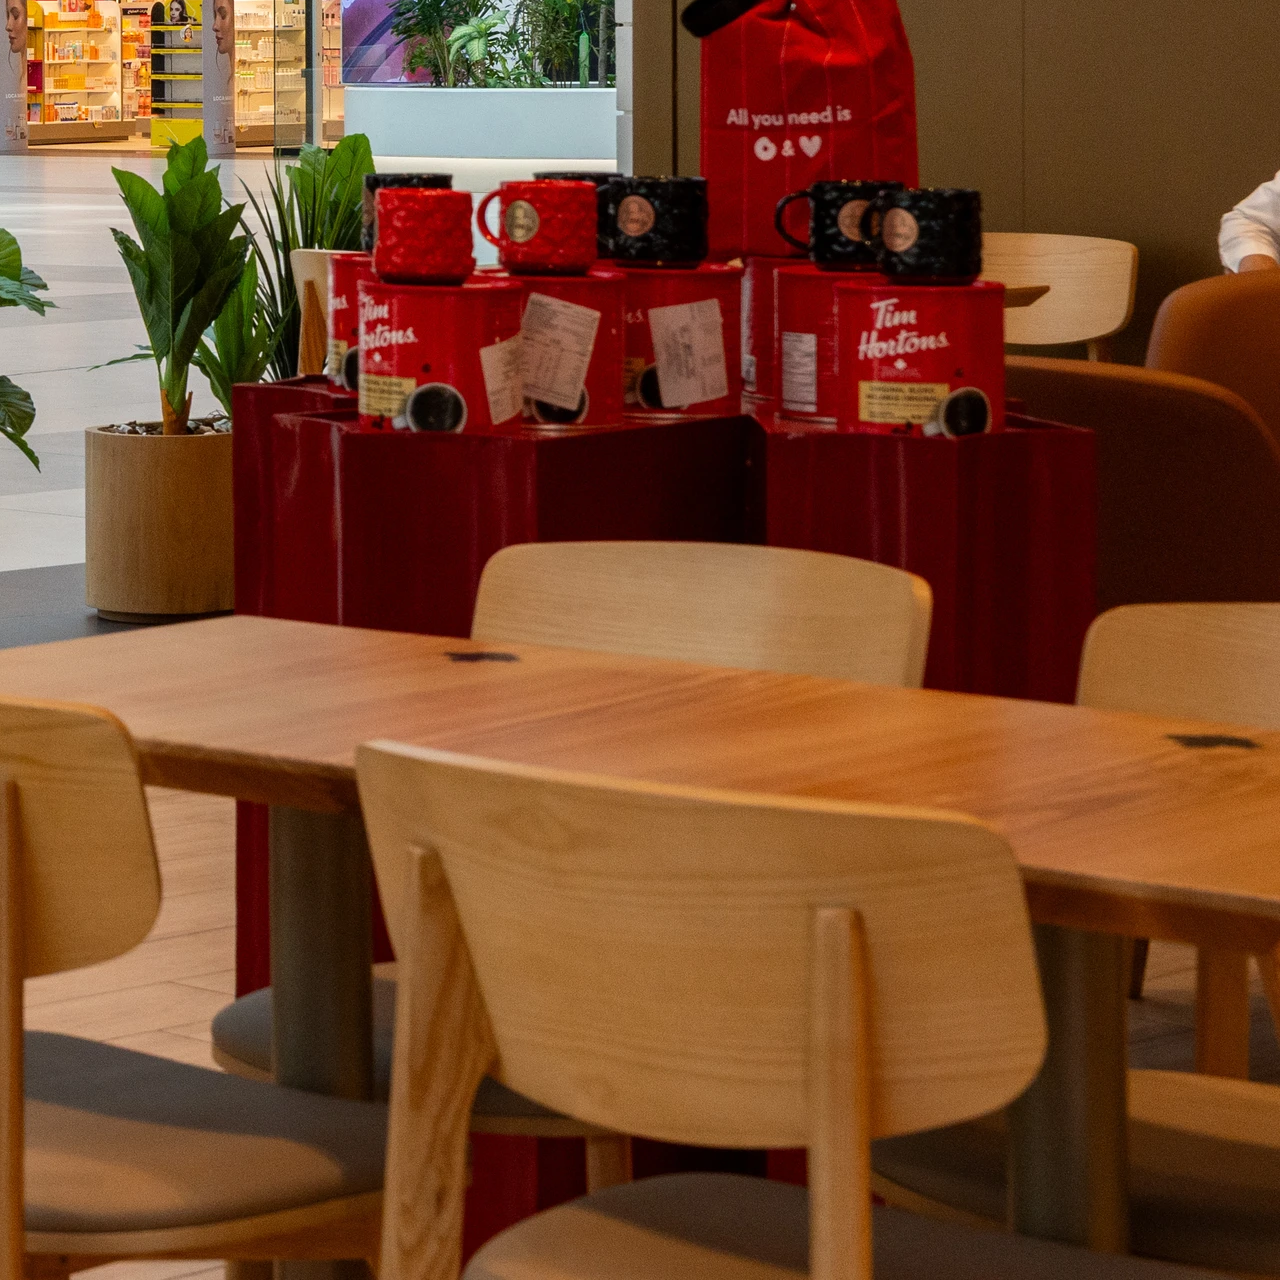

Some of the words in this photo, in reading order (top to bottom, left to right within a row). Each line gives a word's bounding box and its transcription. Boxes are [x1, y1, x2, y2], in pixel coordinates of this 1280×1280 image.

[726, 108, 749, 126] All
[751, 113, 784, 130] you
[787, 105, 833, 125] need
[836, 105, 852, 121] is
[781, 140, 796, 157] &
[870, 298, 918, 329] Tim
[858, 330, 950, 361] Hortons
